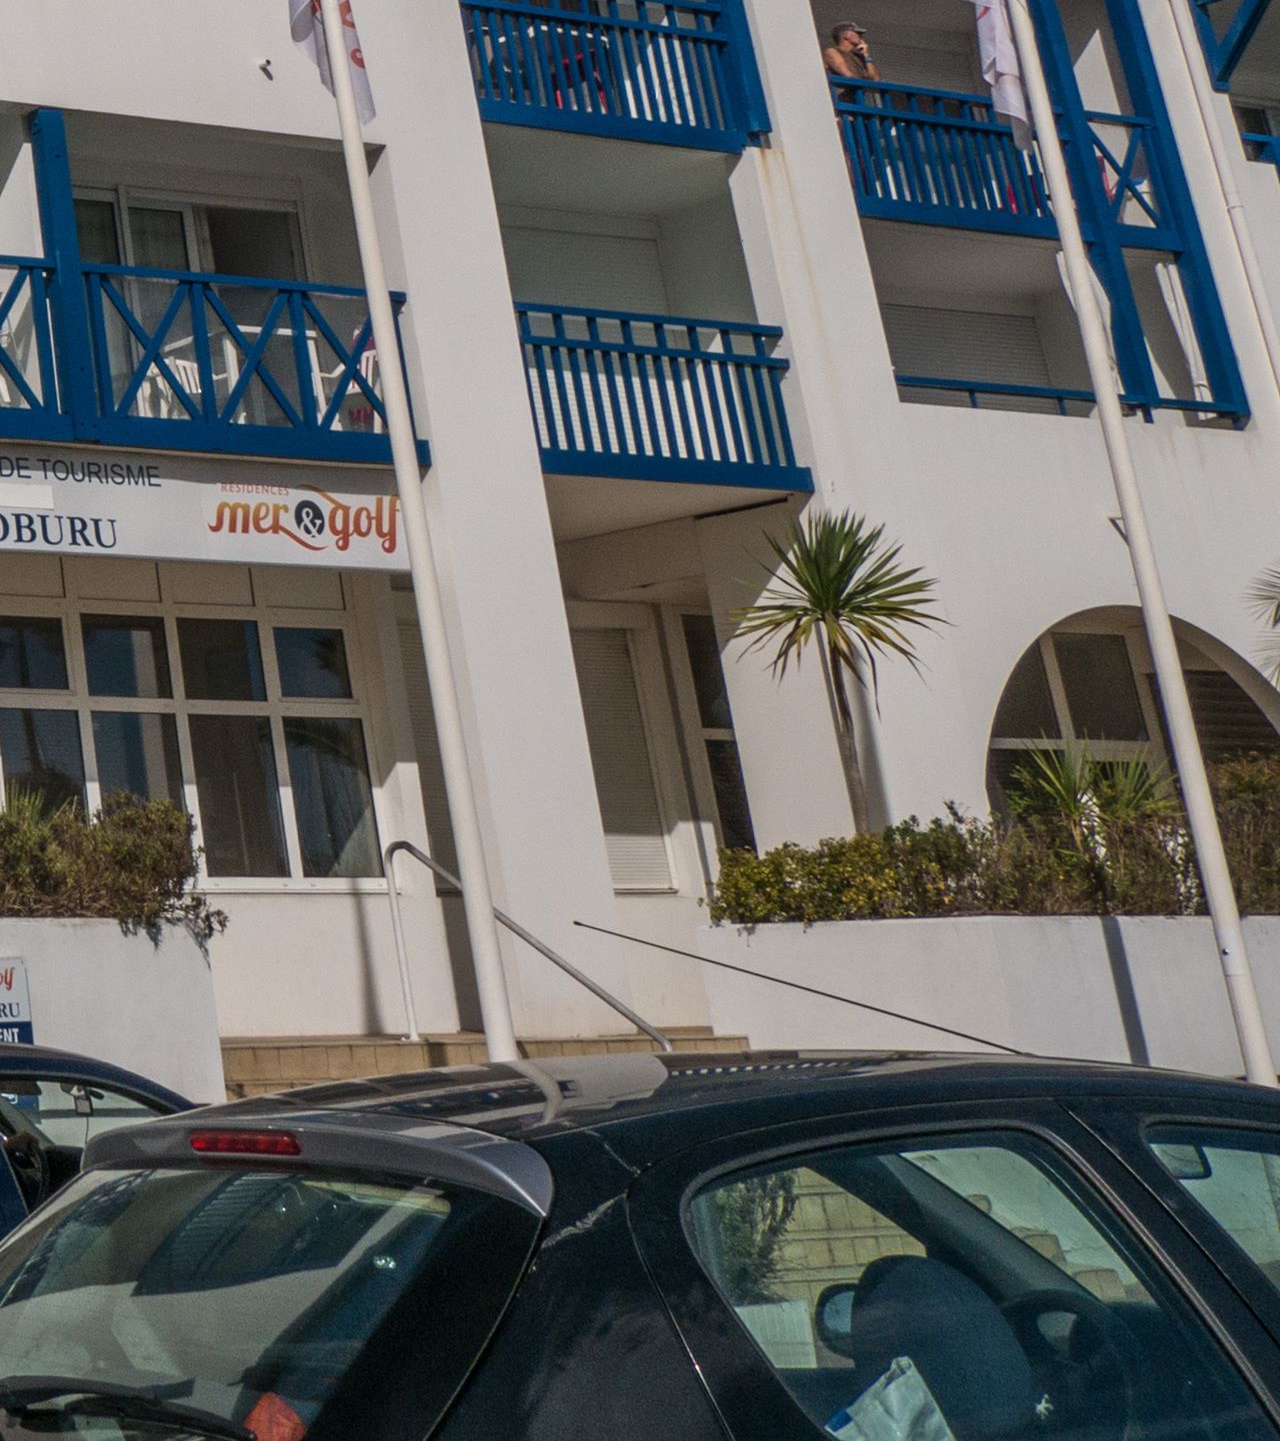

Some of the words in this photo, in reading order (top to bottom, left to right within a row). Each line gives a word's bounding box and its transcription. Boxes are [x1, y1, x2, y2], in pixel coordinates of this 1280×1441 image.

[40, 458, 162, 488] TOURISME
[208, 500, 308, 543] mer
[310, 488, 400, 554] golf
